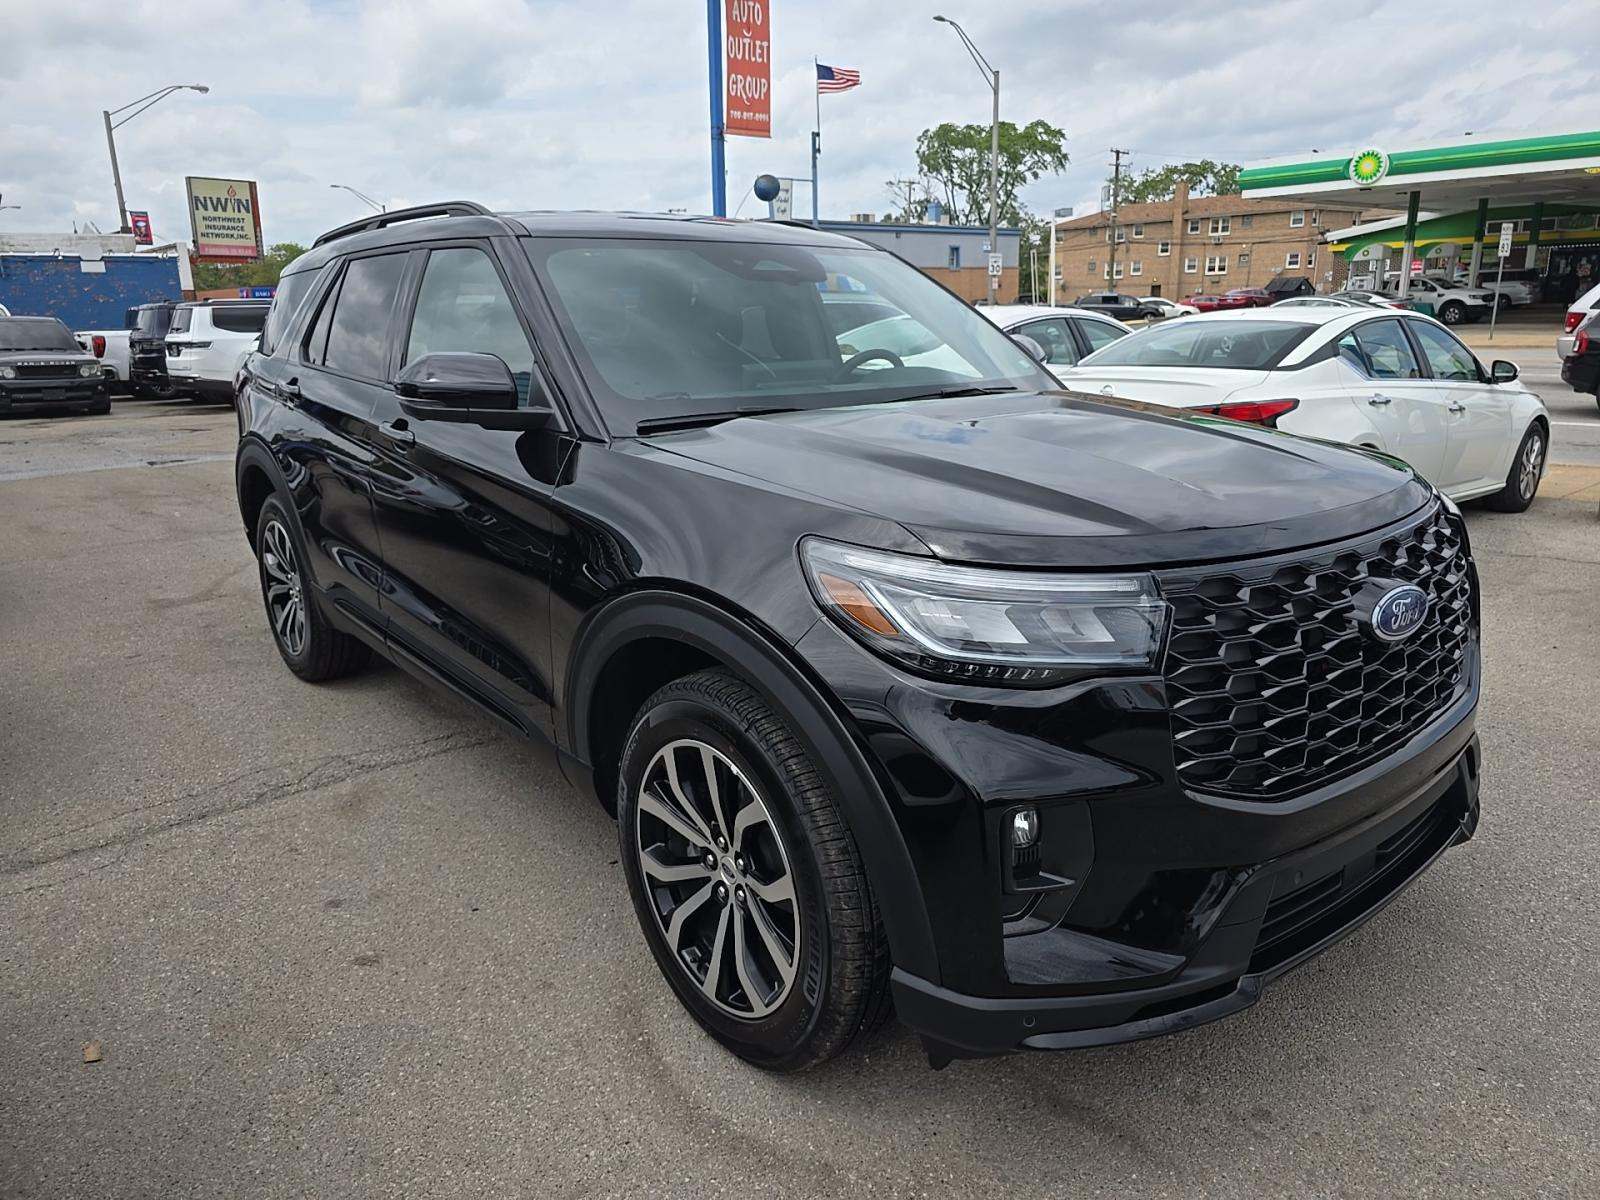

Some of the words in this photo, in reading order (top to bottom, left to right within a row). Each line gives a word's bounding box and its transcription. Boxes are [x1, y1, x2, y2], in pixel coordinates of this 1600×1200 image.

[732, 0, 763, 26] AUTO
[728, 34, 769, 64] OUTLET
[729, 73, 768, 105] GROUP
[202, 215, 246, 224] NORTHWEST
[204, 224, 245, 232] INSURANCE
[990, 264, 1001, 273] 30
[1391, 597, 1421, 630] Ford
